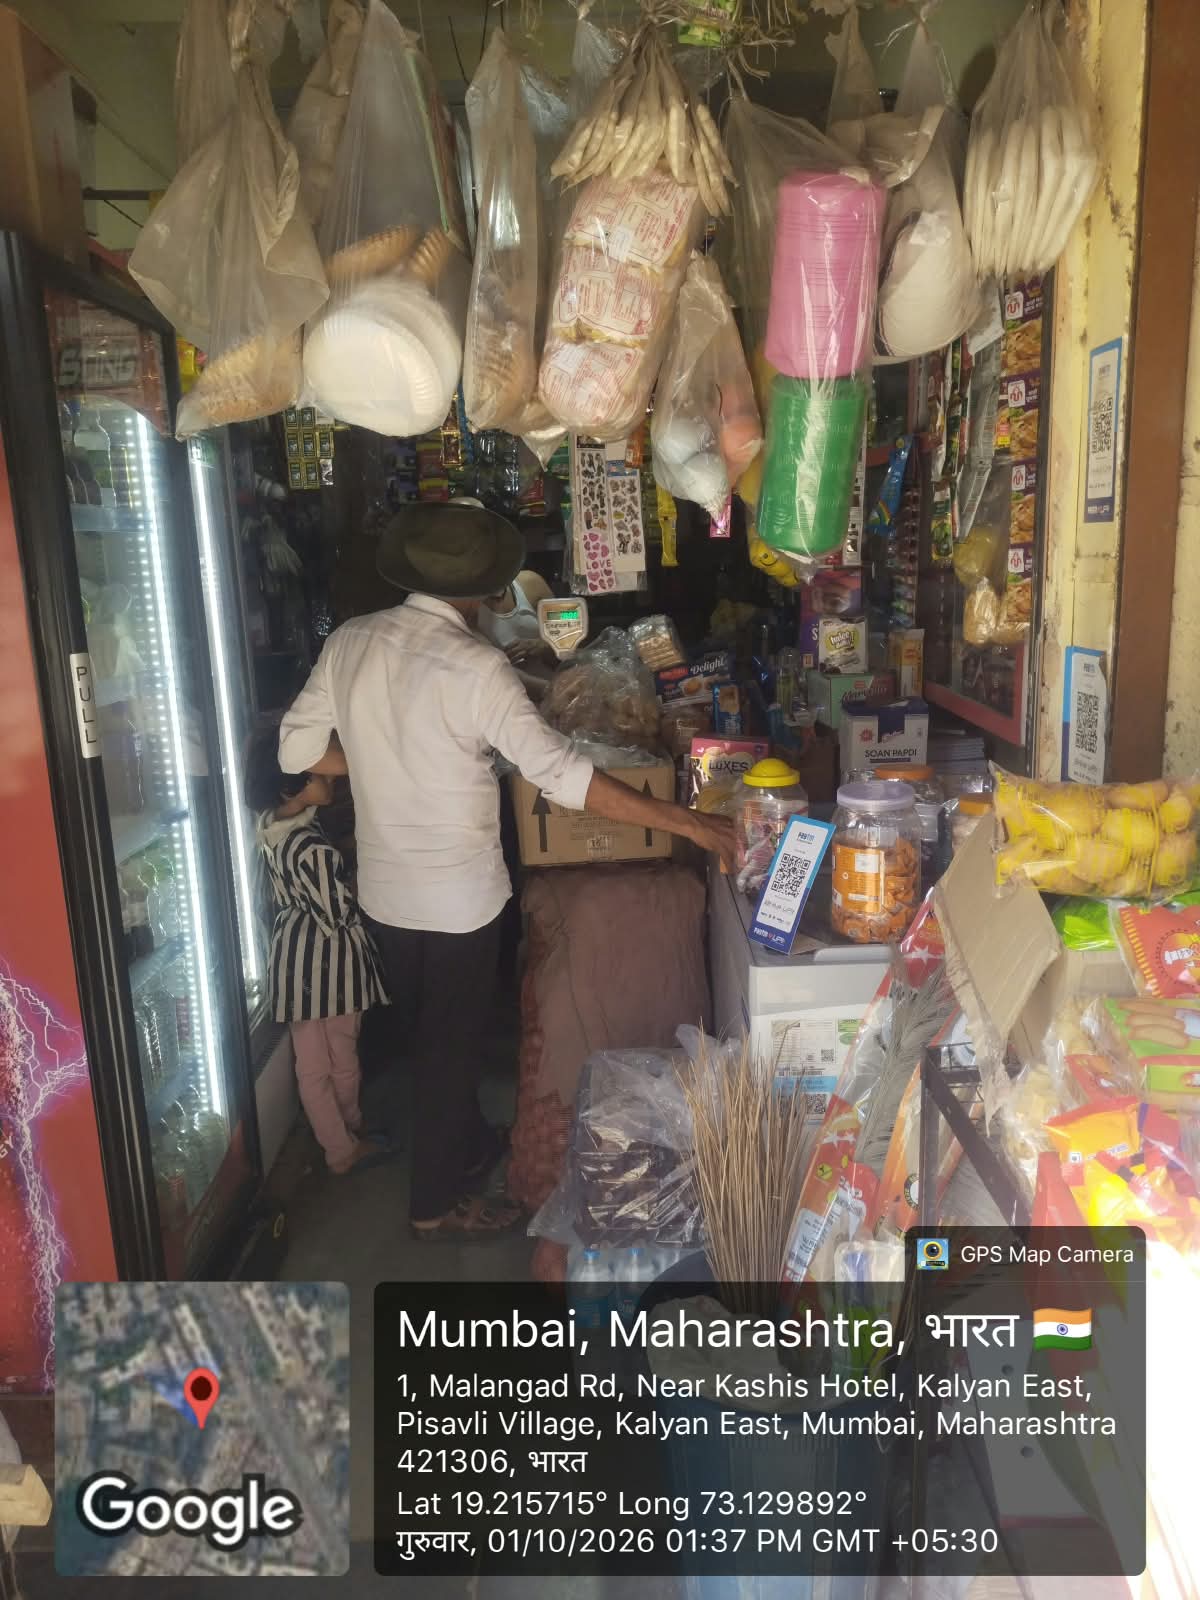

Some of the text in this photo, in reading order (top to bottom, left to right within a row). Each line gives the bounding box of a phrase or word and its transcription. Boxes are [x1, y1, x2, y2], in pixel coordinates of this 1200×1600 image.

[586, 560, 612, 570] LOVE
[690, 656, 724, 675] Delight
[76, 666, 97, 744] PULL
